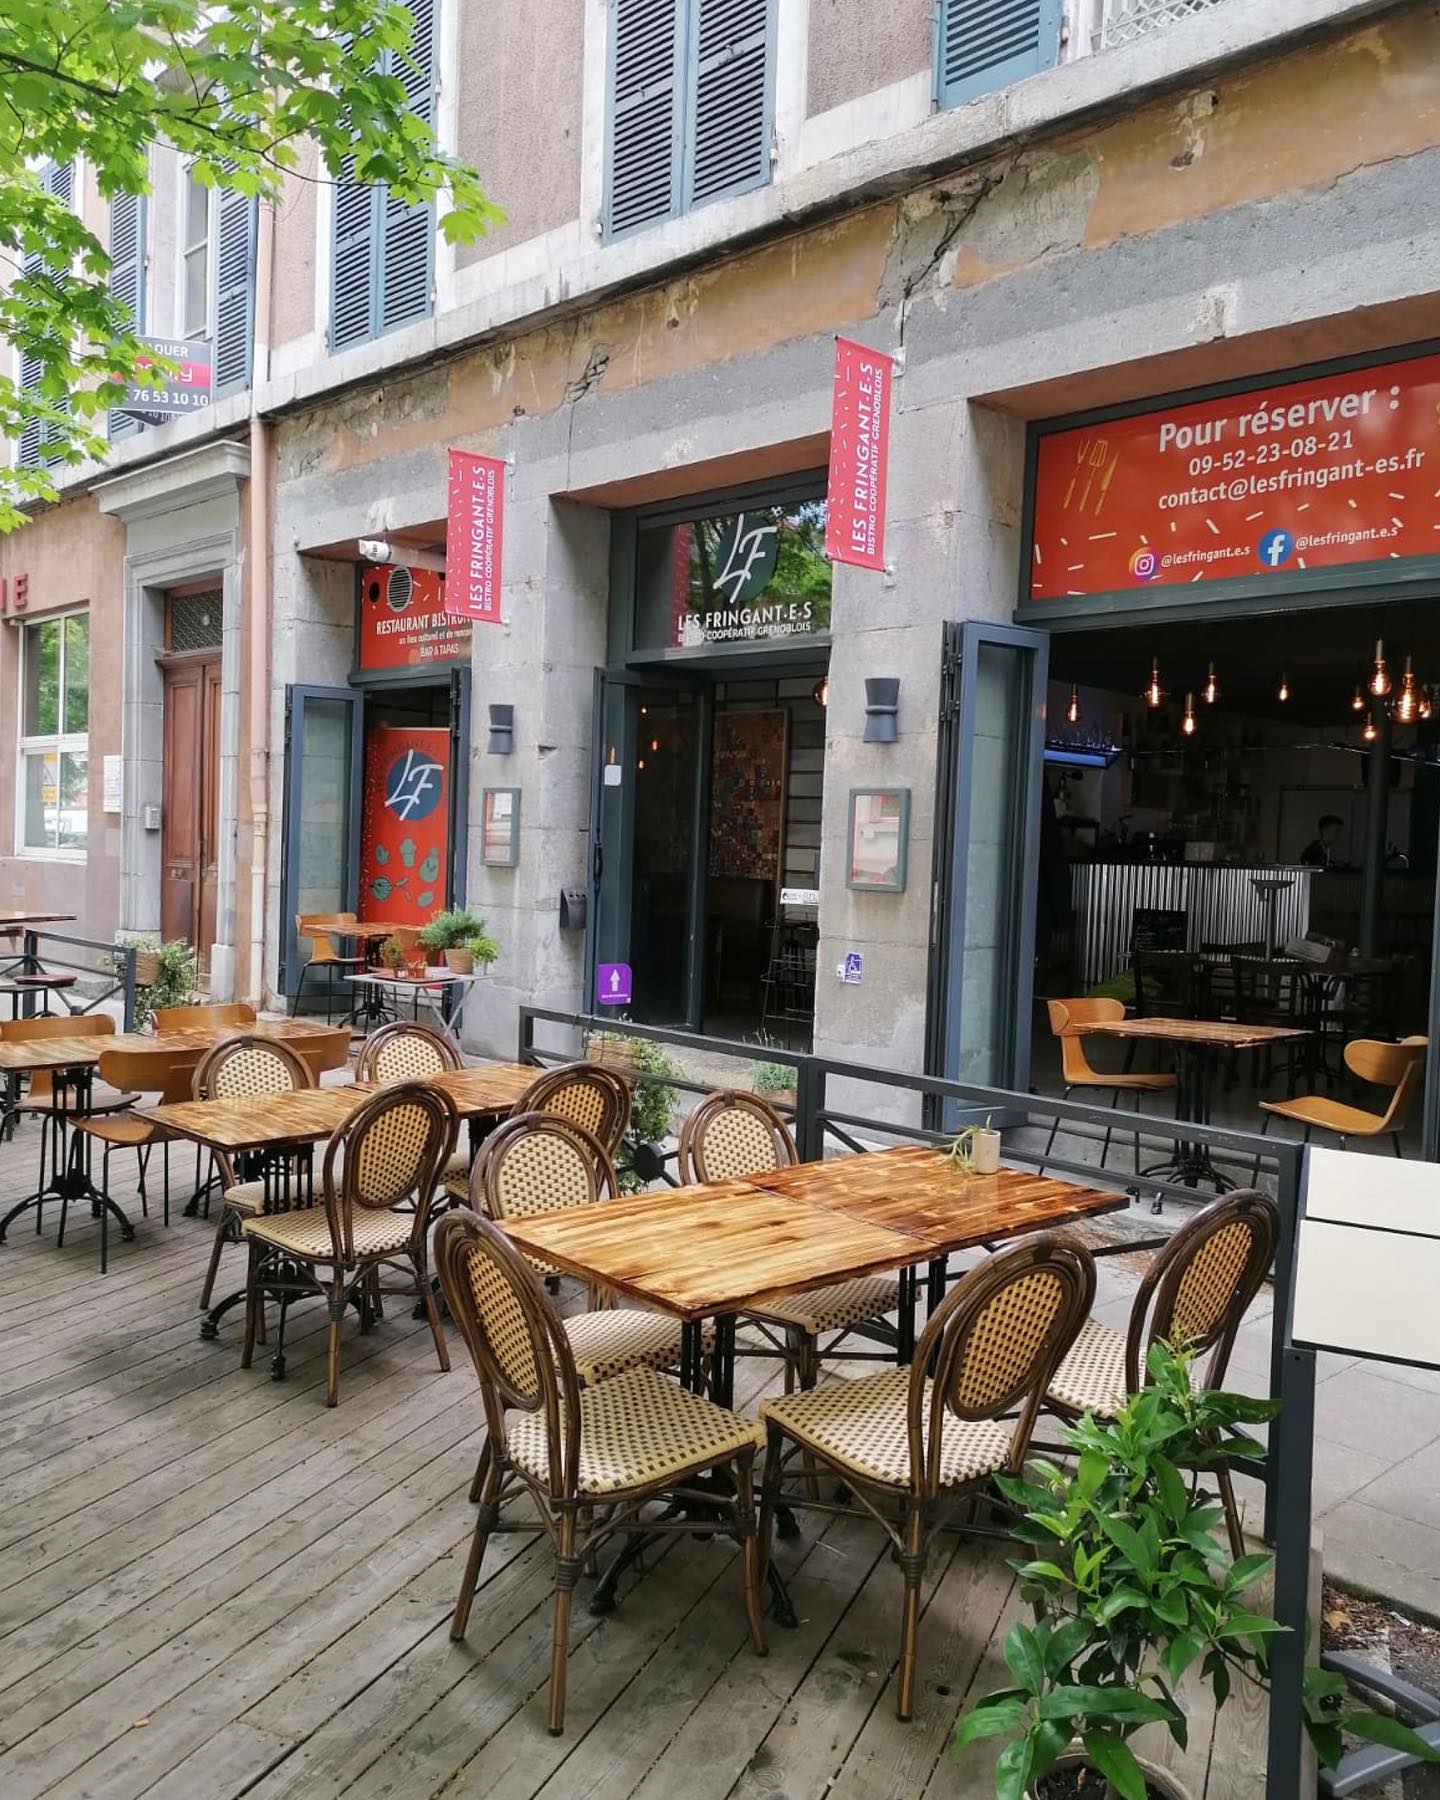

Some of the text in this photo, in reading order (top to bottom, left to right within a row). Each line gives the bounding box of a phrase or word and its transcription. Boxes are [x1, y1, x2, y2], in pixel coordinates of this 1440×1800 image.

[149, 343, 189, 358] OUER
[133, 389, 209, 407] 76 53 10 10
[1159, 416, 1227, 453] Pour
[1238, 388, 1377, 437] réserver
[867, 368, 883, 555] BISTRO COOPÉRATIF GRENOBLOIS
[1188, 430, 1354, 477] 09-52-23-08-21
[1158, 448, 1426, 509] contact@lesfringant-es.fr
[851, 519, 867, 553] LES
[1161, 526, 1399, 568] @lesfringant.e.s @lesfringant.e.s
[469, 584, 483, 610] LES
[376, 614, 430, 636] RESTAURANT
[678, 613, 700, 631] LES
[439, 643, 459, 656] TAPAS
